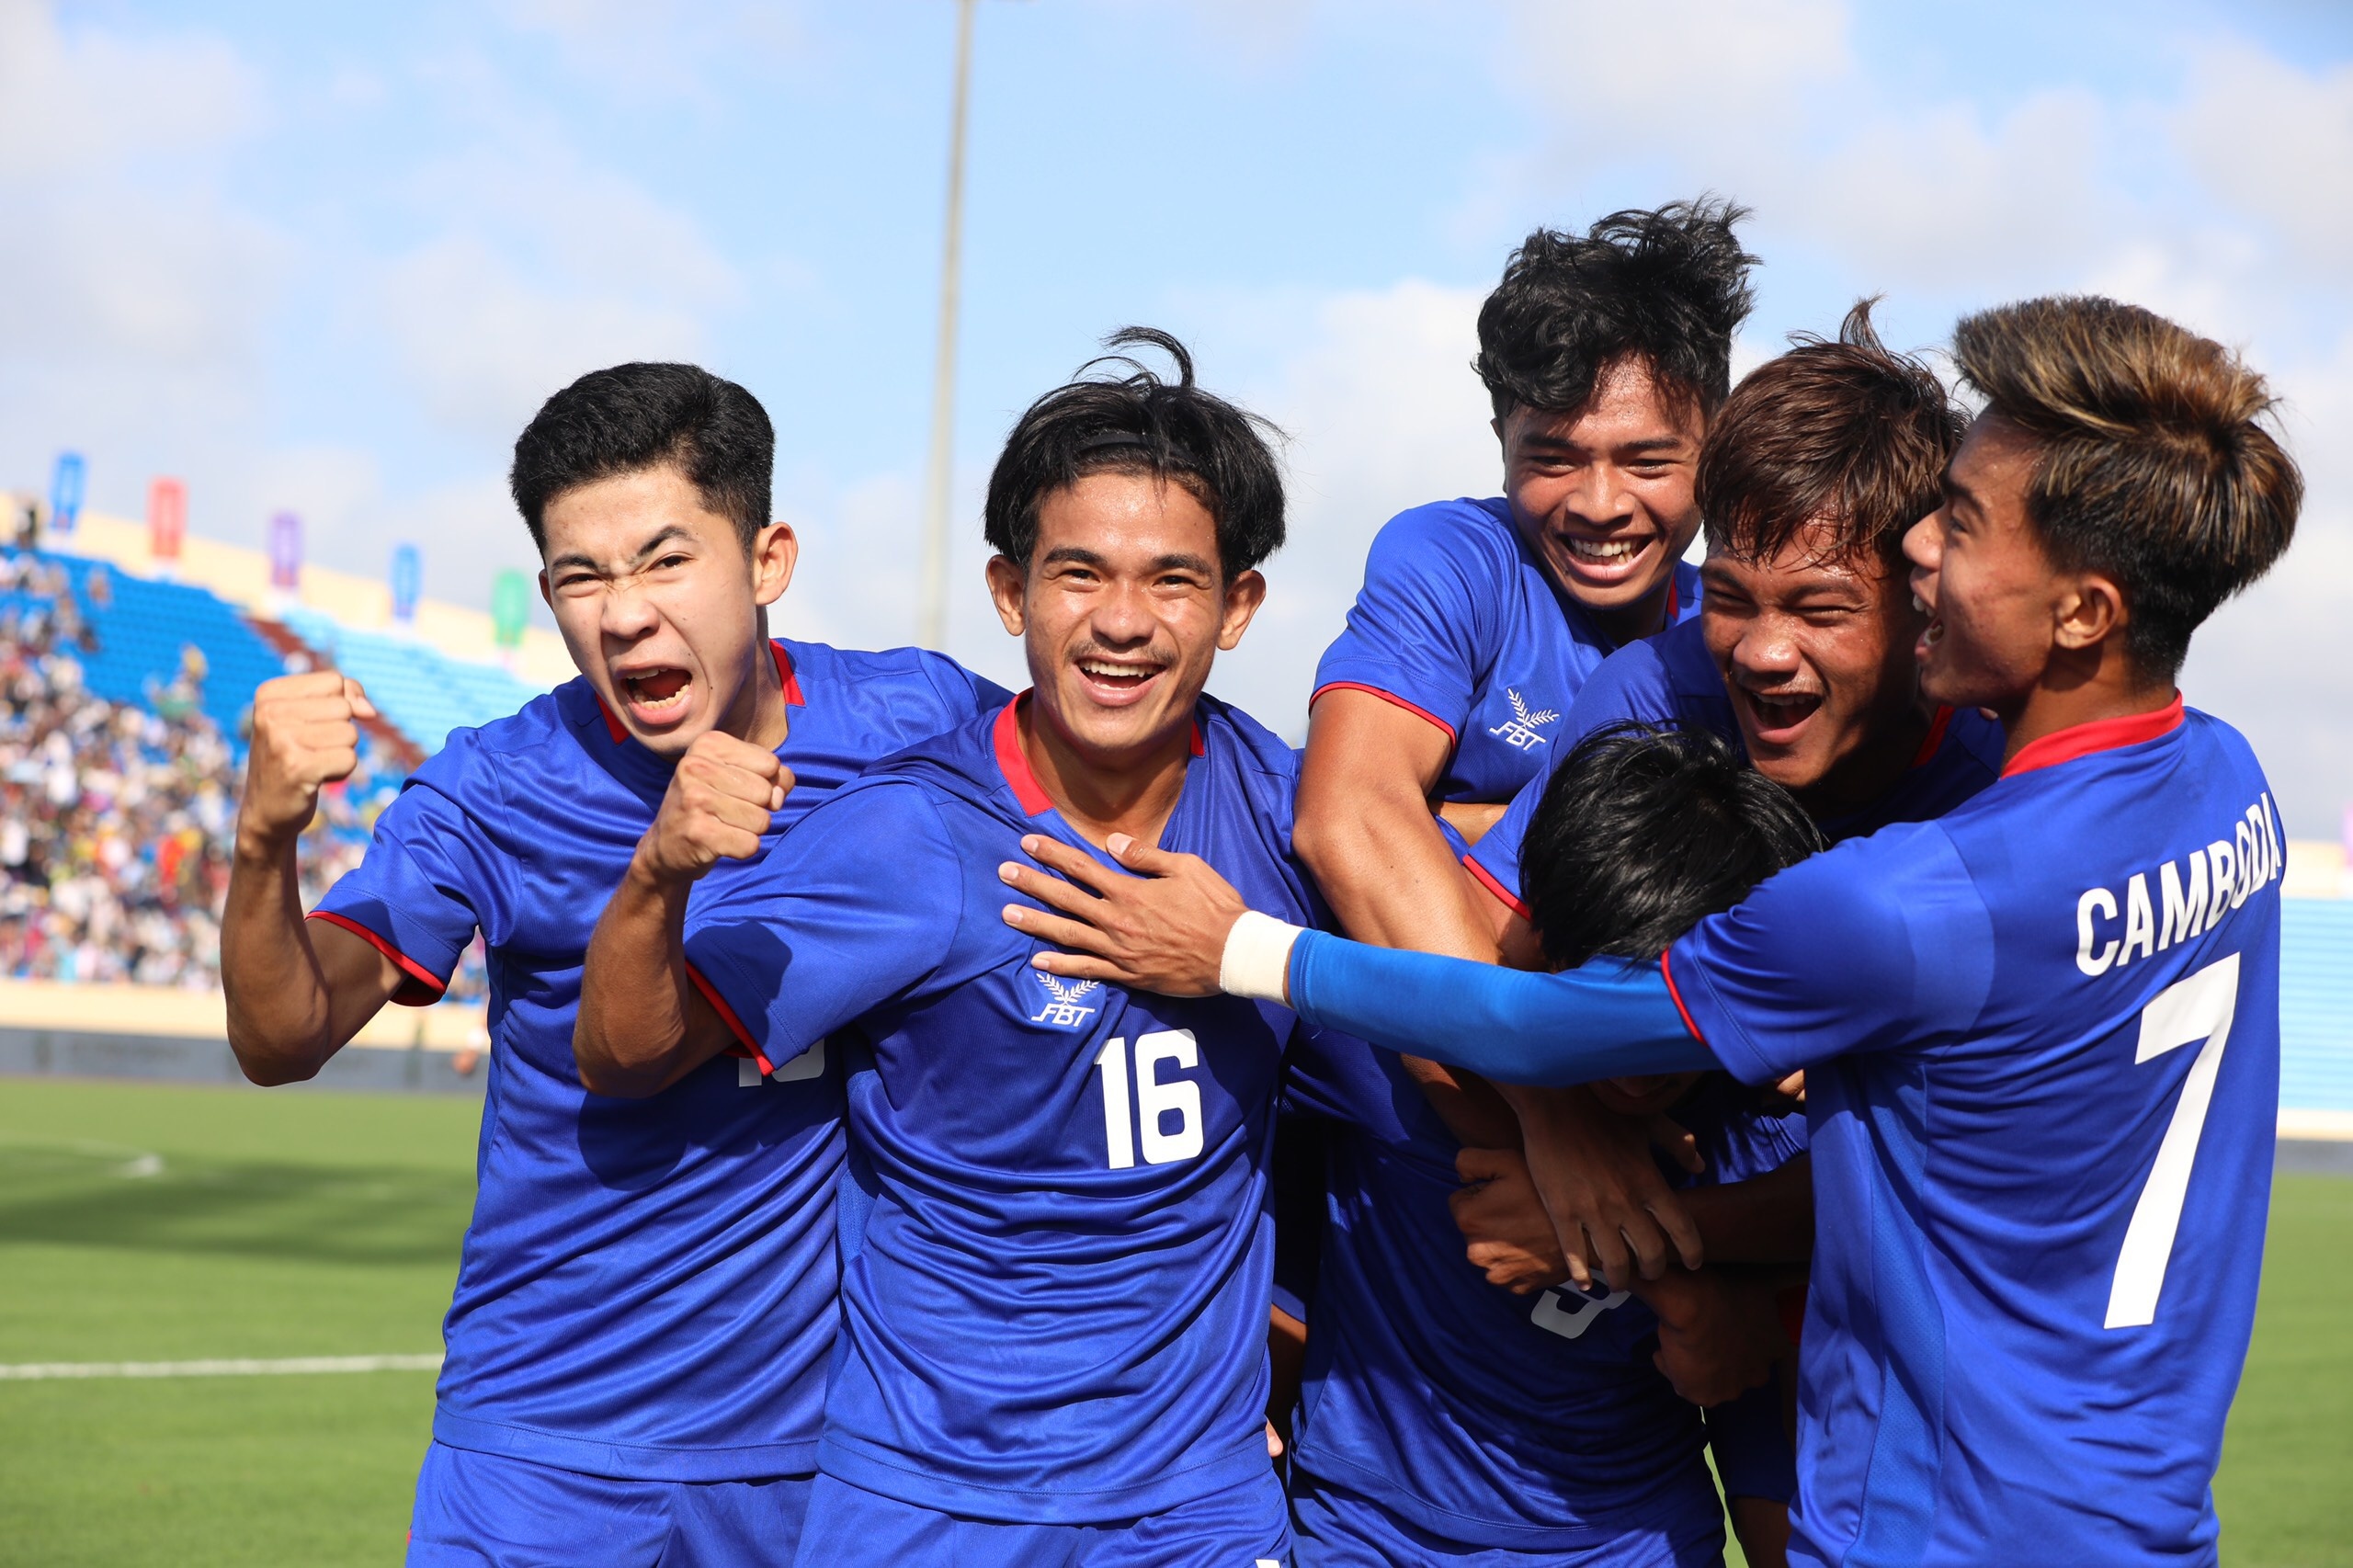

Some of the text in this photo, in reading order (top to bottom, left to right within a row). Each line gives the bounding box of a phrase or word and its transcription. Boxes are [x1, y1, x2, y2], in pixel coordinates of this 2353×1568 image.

[1489, 721, 1546, 751] FBT
[2075, 791, 2281, 977] CAMBODI
[1031, 1003, 1095, 1027] FBT
[1093, 1028, 1204, 1170] 16
[2103, 951, 2240, 1329] 7
